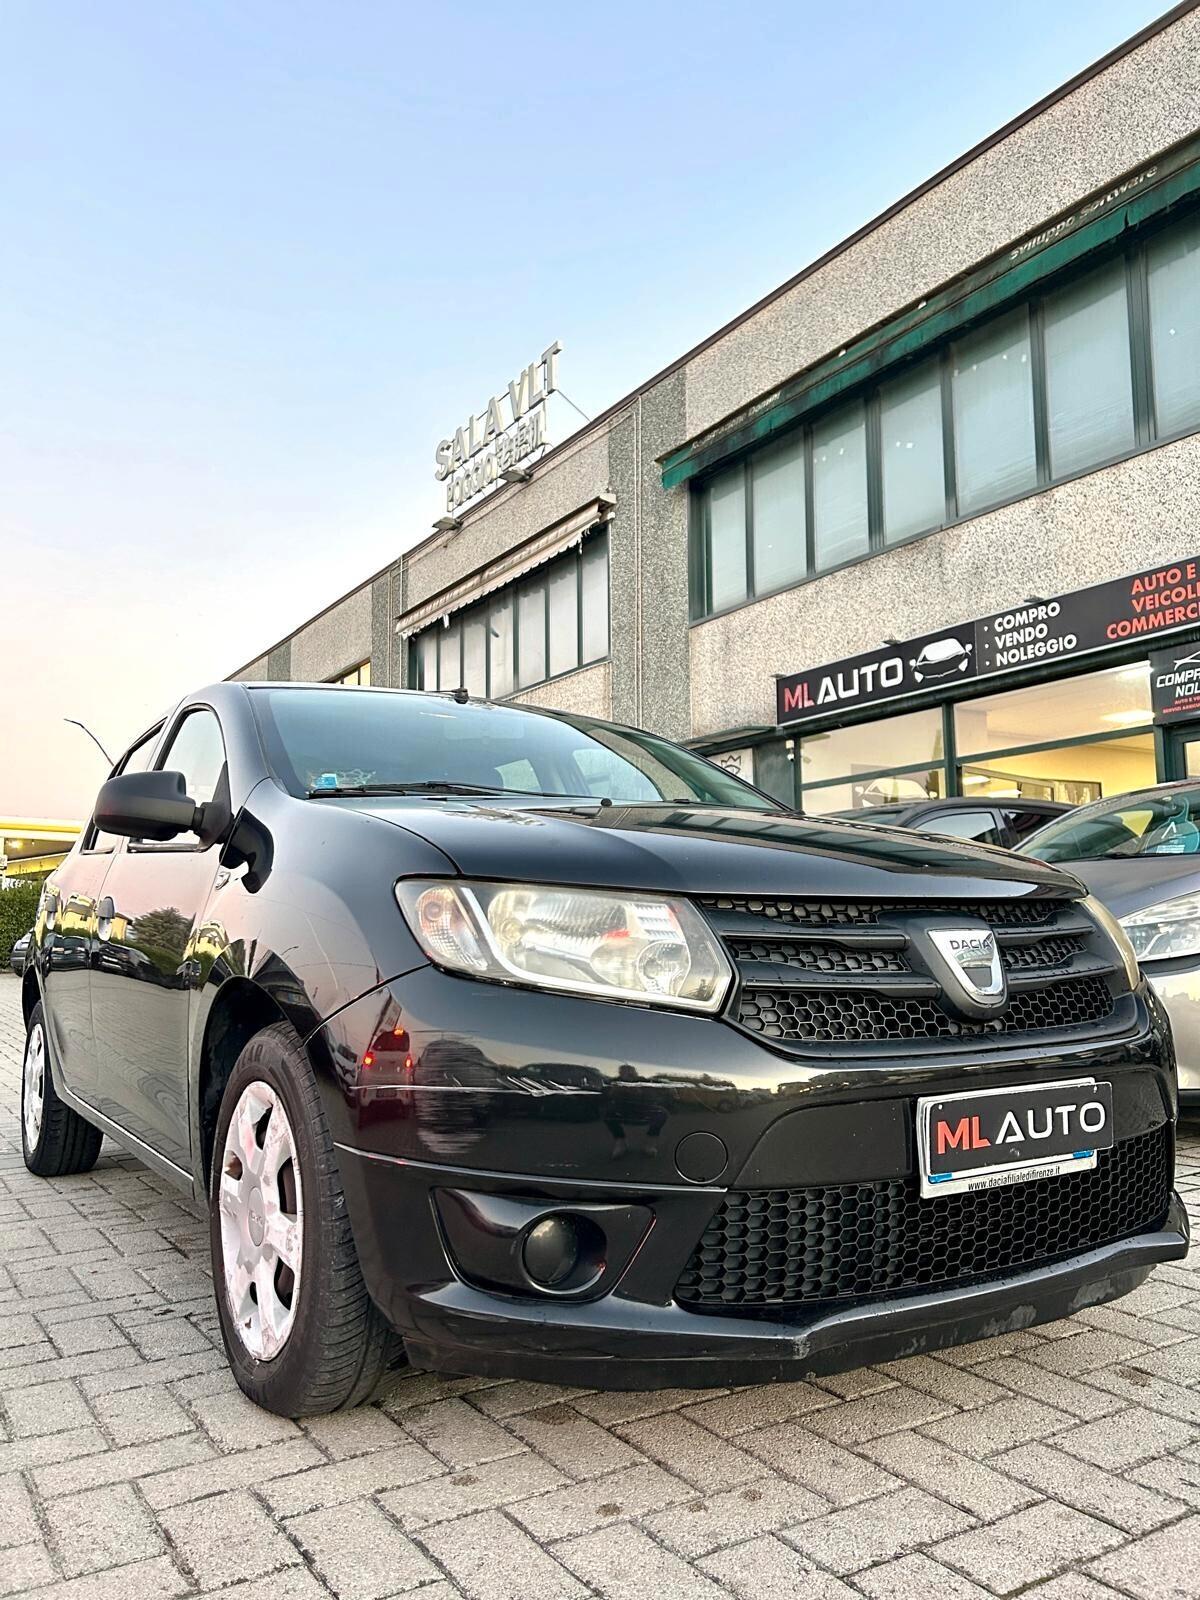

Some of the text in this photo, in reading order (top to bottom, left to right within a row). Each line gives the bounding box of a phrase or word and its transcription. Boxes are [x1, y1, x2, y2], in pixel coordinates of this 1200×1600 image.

[435, 341, 562, 481] SALA VLT
[1131, 562, 1196, 595] AUTO E
[994, 601, 1061, 633] COMPRO
[994, 623, 1049, 650] VENDO
[995, 634, 1078, 667] NOLEGGIO
[784, 657, 904, 713] ML AUTO
[949, 939, 992, 950] DACIA
[937, 1102, 1106, 1154] ML AUTO
